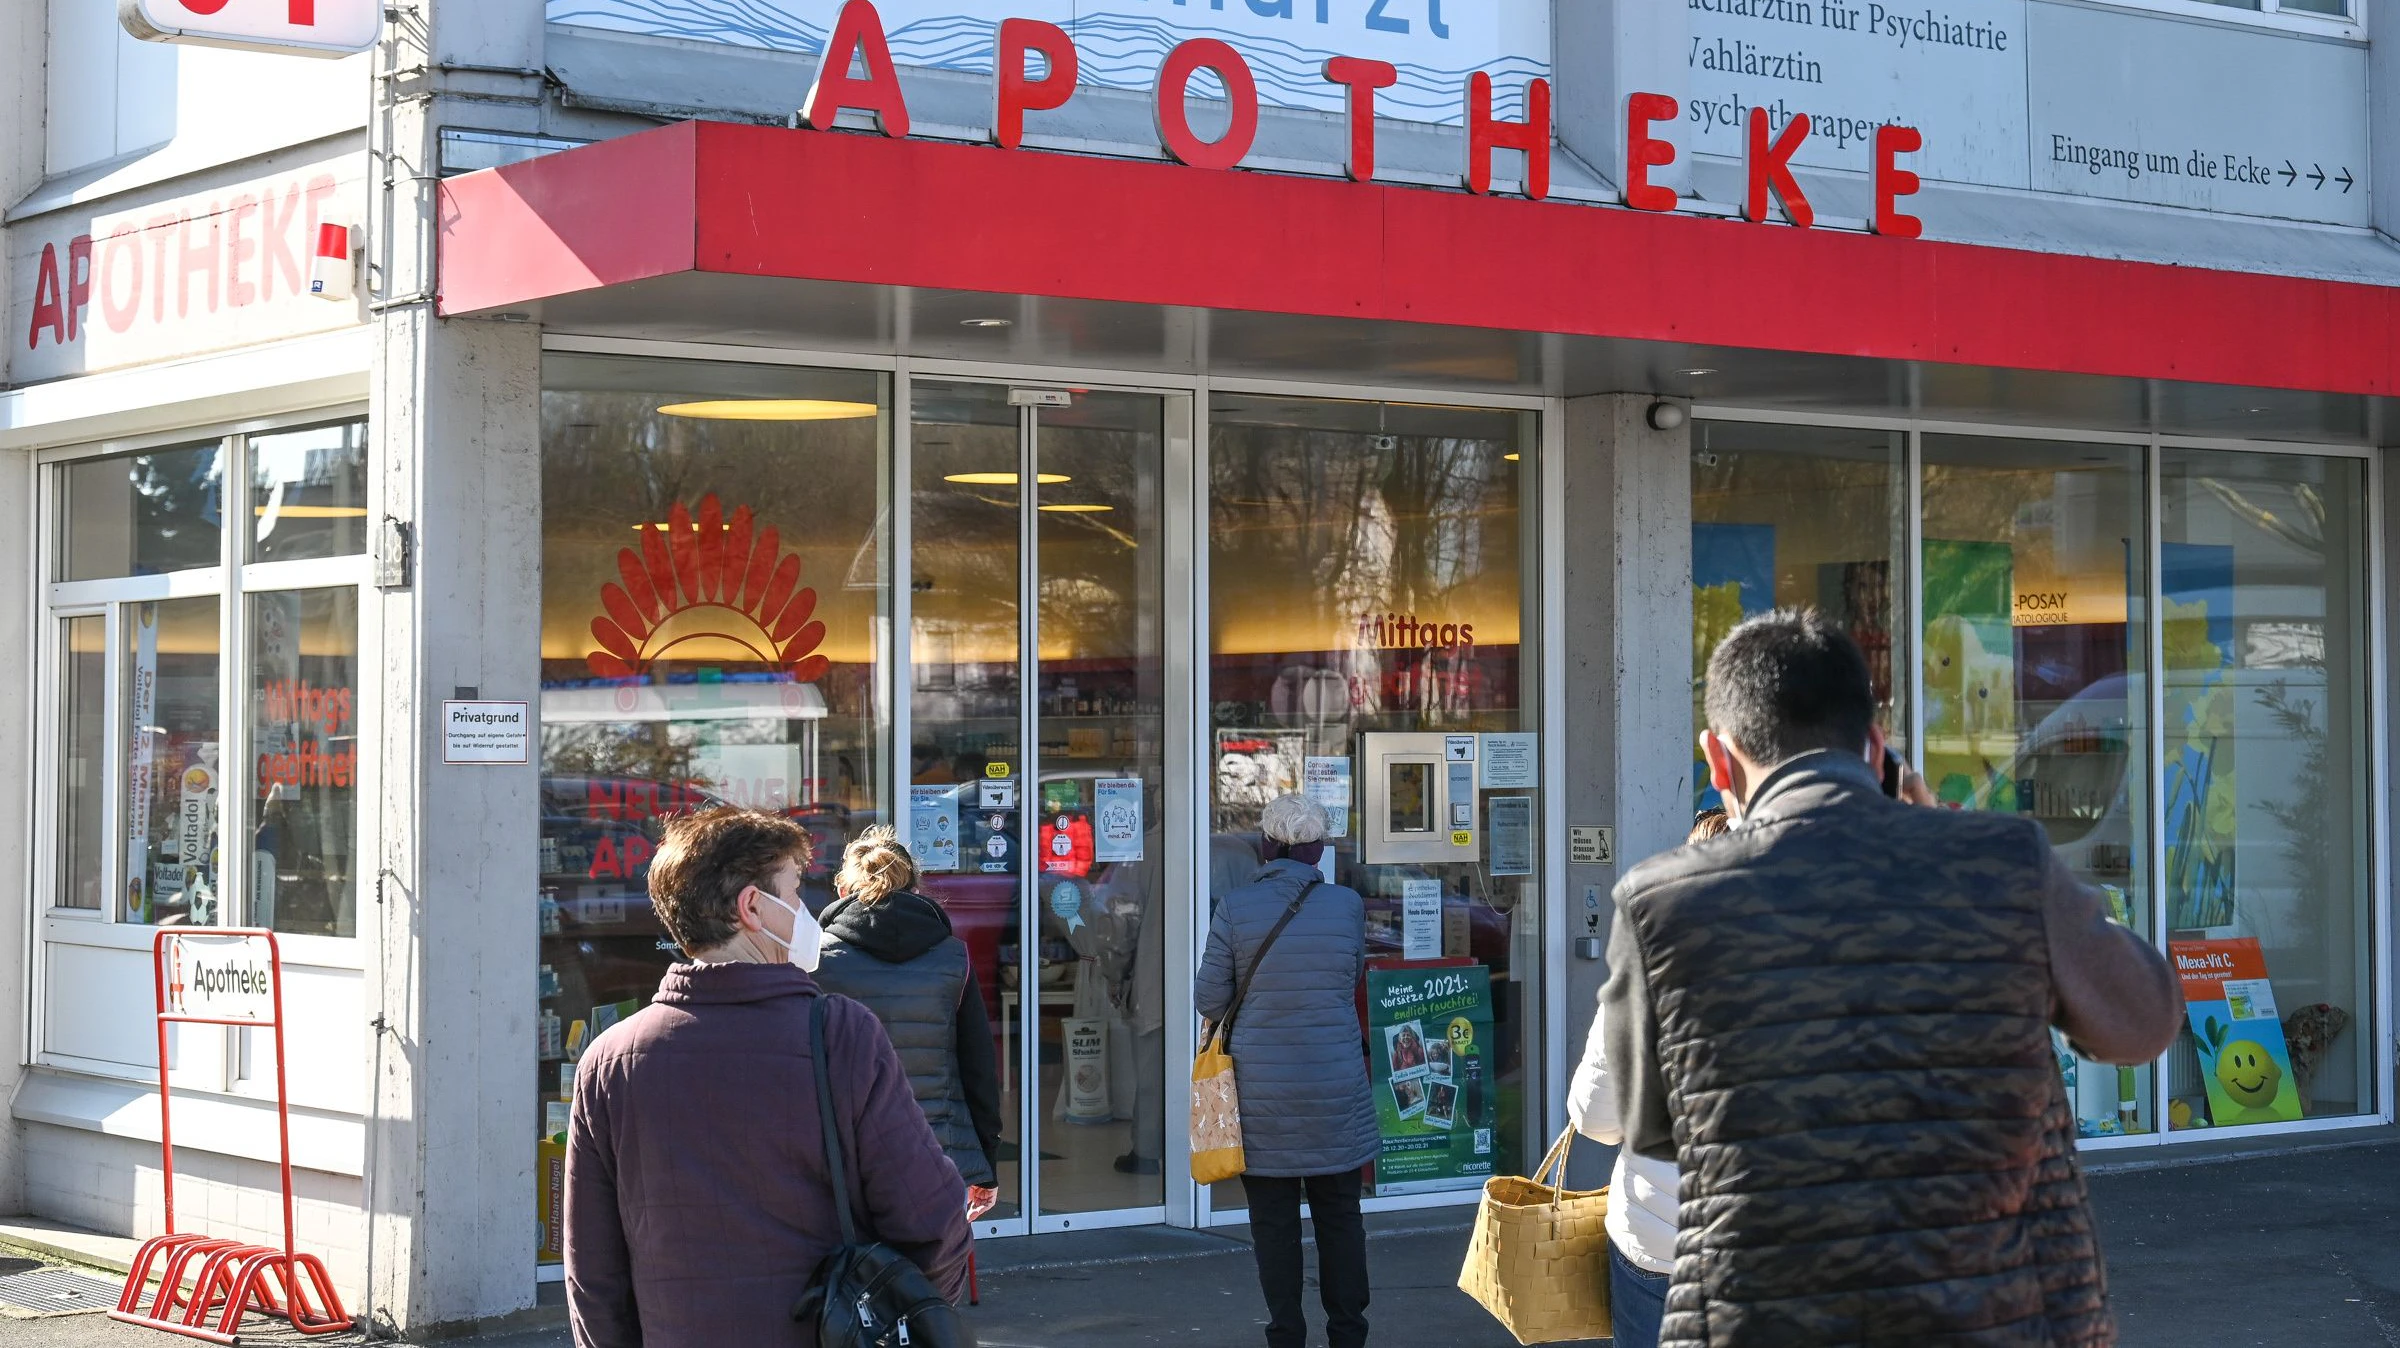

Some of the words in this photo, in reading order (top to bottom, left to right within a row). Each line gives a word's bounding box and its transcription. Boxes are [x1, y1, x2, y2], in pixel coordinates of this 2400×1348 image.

[1822, 0, 1860, 31] für
[1868, 3, 2008, 52] Psychiatrie
[803, 0, 1922, 240] APOTHEKE
[2051, 134, 2140, 179] Eingang
[2145, 153, 2181, 175] um
[2186, 150, 2217, 179] die
[2223, 155, 2271, 185] Ecke
[28, 172, 337, 350] APOTHEKE
[1358, 613, 1474, 657] Mittags
[135, 665, 144, 721] Voltadol
[264, 678, 352, 735] Mittags
[452, 712, 520, 725] Privatgrund
[184, 799, 199, 863] Voltadol
[1121, 831, 1132, 839] 2m
[154, 867, 185, 882] Voltadol
[655, 940, 683, 951] Sams
[2176, 953, 2223, 970] Mexa-Vit
[2222, 952, 2235, 968] C.
[194, 959, 268, 1002] Apotheke
[1388, 984, 1413, 996] Meine
[1424, 973, 1469, 1000] 2021:
[1381, 993, 1424, 1008] Vorsätze
[1394, 1005, 1428, 1020] endlich
[1429, 992, 1480, 1013] rauchfrei!
[1072, 1038, 1101, 1047] SLIM
[1450, 1024, 1469, 1040] 3€
[1072, 1048, 1102, 1056] Shake
[551, 1159, 562, 1192] Nägel
[1462, 1161, 1492, 1171] nicorette
[551, 1193, 561, 1225] Haare
[551, 1225, 561, 1252] Haut
